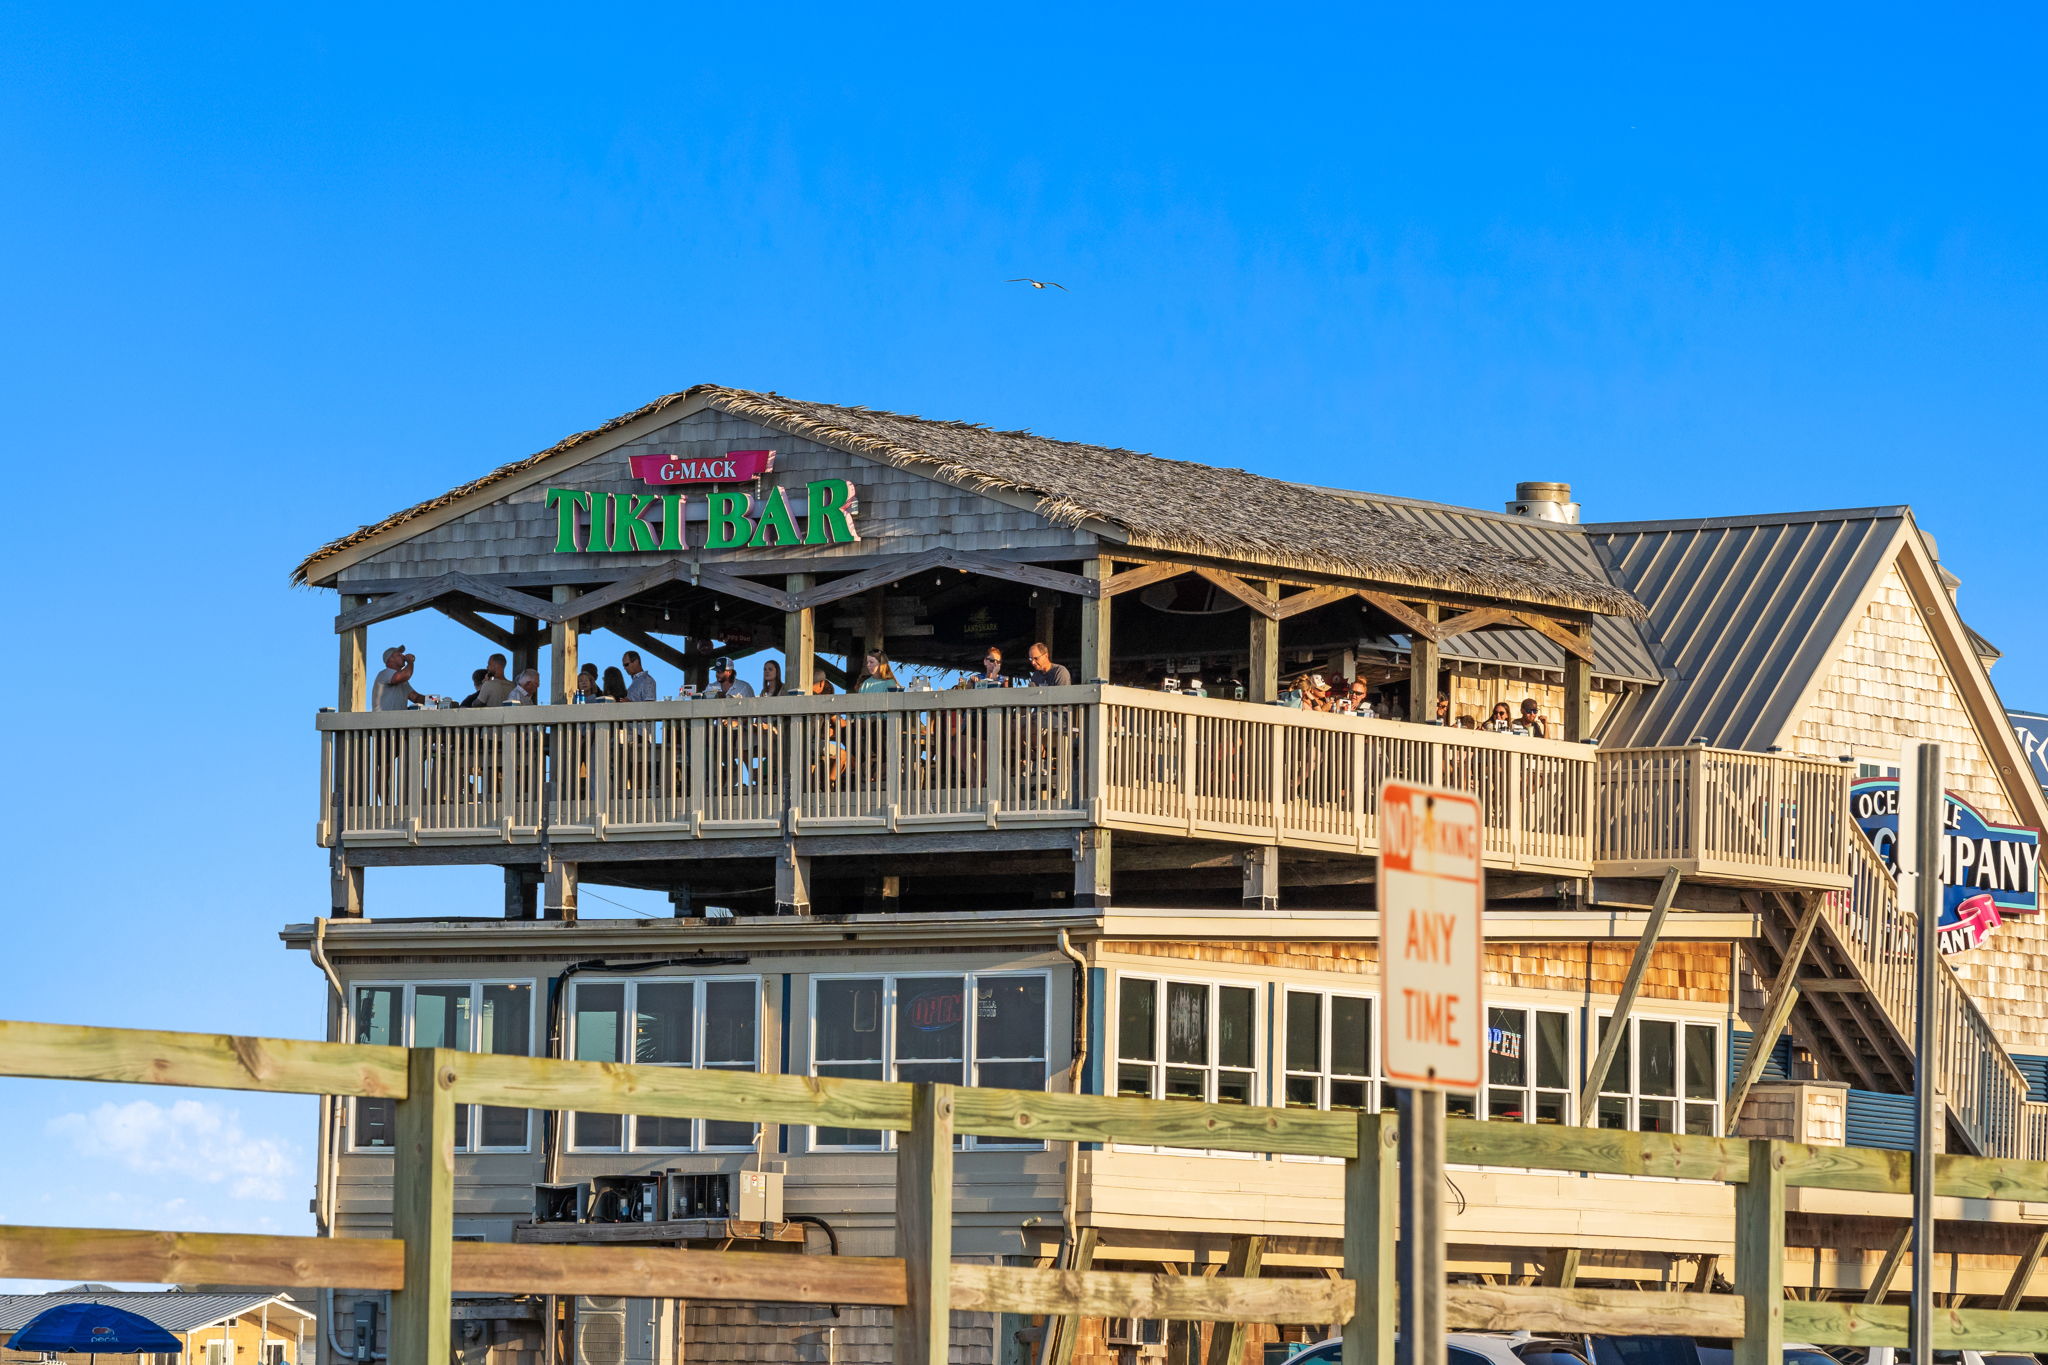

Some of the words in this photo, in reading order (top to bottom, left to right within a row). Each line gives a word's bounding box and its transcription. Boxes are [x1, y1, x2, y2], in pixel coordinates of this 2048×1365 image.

[659, 459, 737, 482] G-MACK
[545, 487, 688, 553] TIKI
[703, 478, 860, 550] BAR
[1383, 800, 1411, 859] NO
[1411, 815, 1475, 860] PARKING
[1858, 789, 1899, 819] OCE
[1873, 827, 2042, 893] CPANY
[1404, 908, 1456, 966] ANY
[1402, 988, 1461, 1048] TIME
